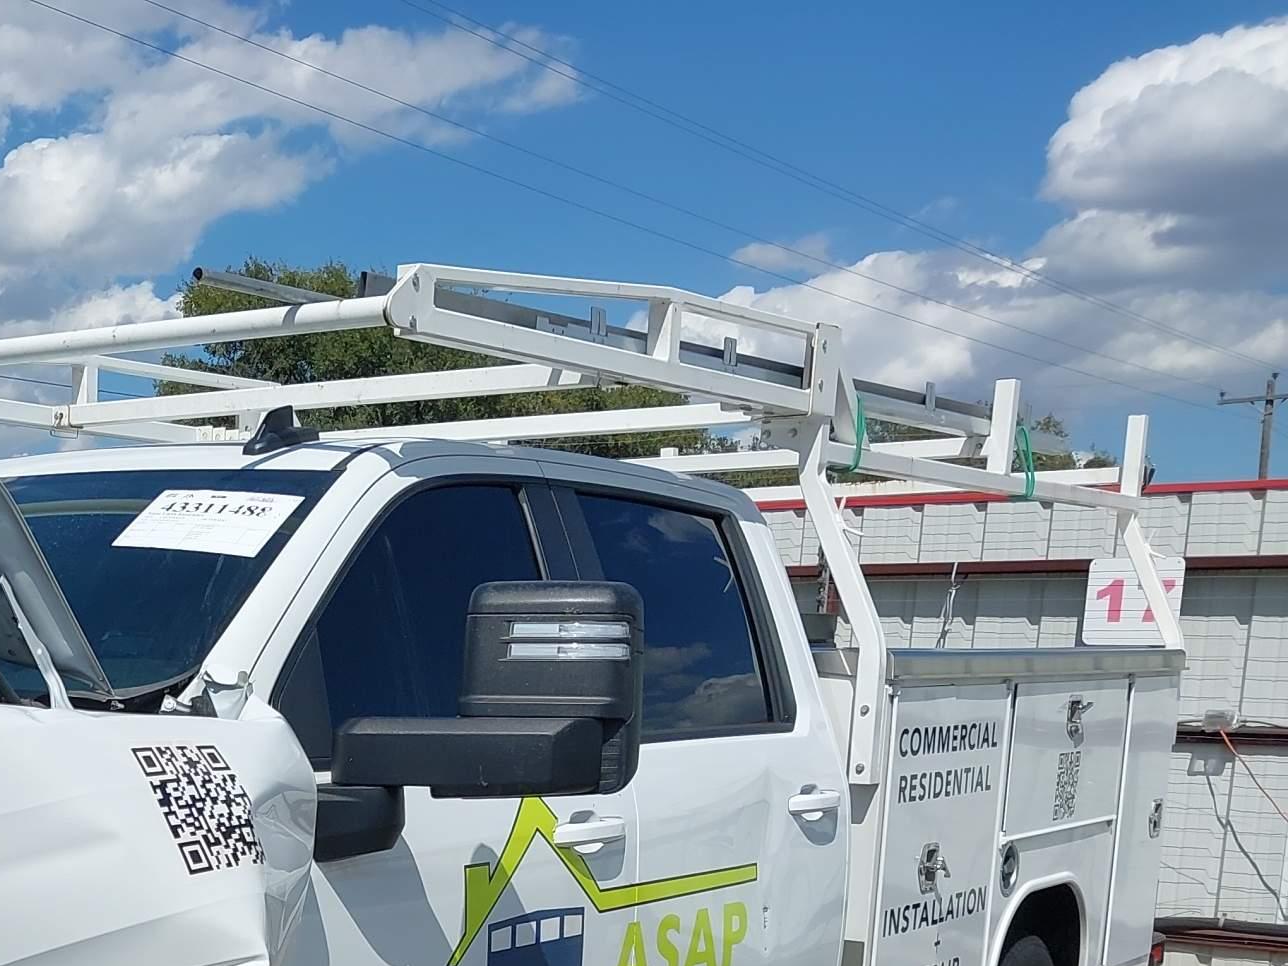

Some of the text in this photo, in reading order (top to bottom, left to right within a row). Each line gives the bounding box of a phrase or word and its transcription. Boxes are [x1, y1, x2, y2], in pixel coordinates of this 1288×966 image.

[159, 502, 274, 518] 43311488
[899, 721, 998, 757] COMMERCIAL
[898, 765, 992, 804] RESIDENTIAL
[882, 886, 987, 938] INSTALLATION
